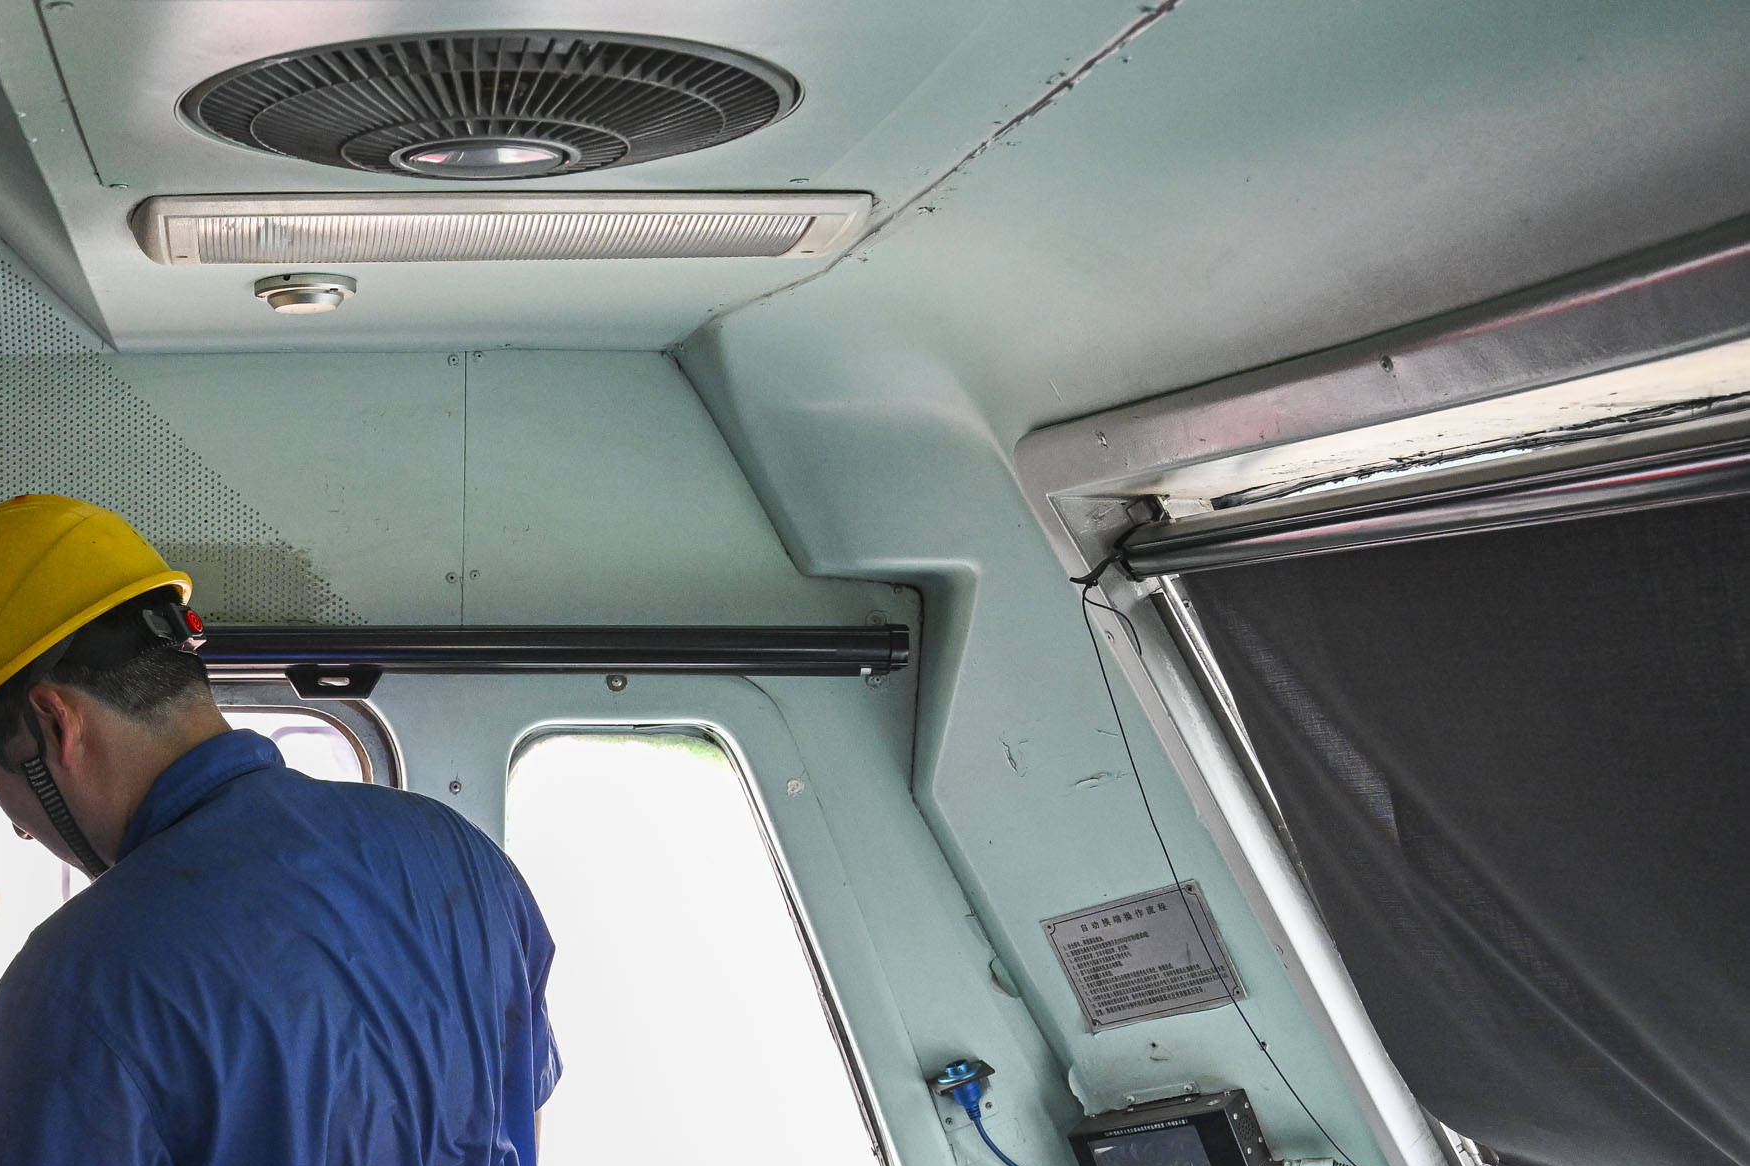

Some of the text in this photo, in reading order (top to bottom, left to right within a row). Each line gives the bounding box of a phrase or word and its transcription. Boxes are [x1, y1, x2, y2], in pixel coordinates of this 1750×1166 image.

[1080, 902, 1169, 932] 自动换端操作流程
